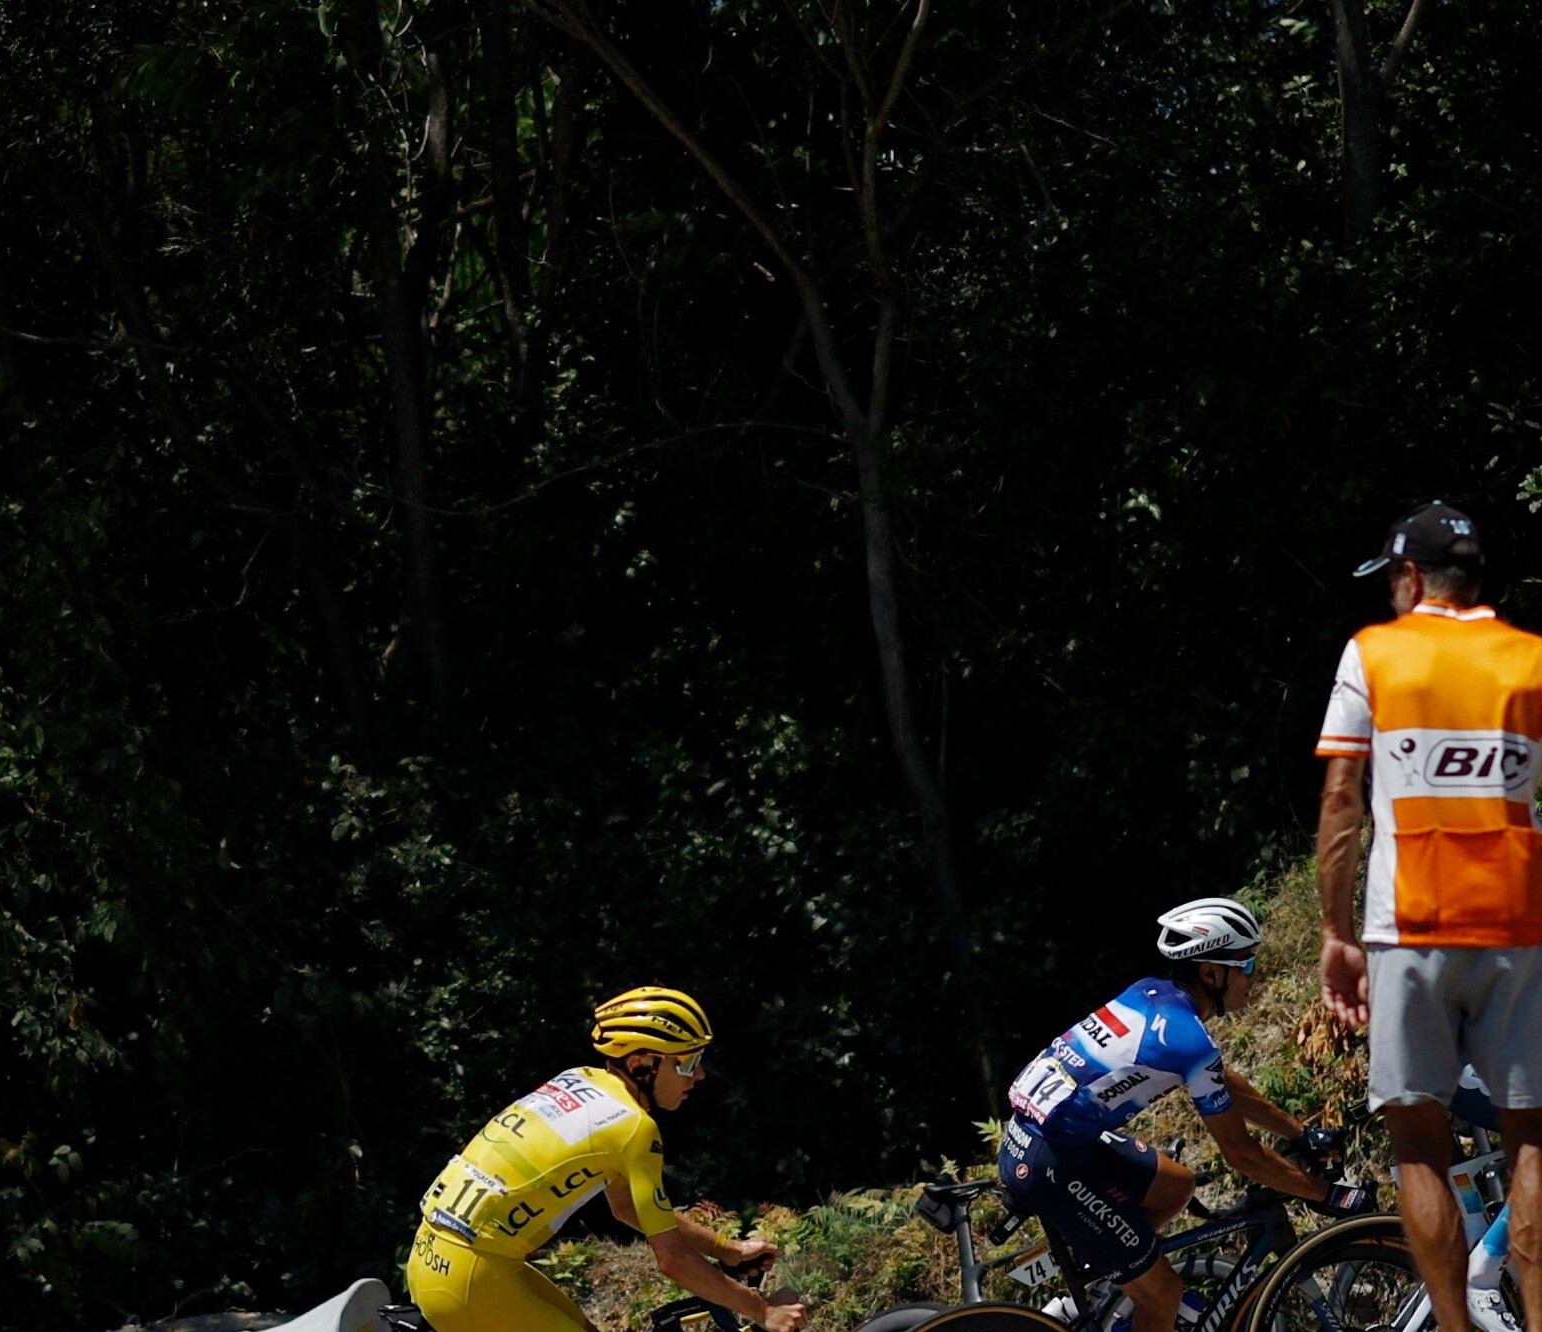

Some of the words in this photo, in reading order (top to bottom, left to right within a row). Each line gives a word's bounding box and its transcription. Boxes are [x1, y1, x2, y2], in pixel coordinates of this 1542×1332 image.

[1097, 1071, 1151, 1103] SOUDAL
[549, 1166, 604, 1199] LCL
[444, 1178, 489, 1226] 11
[498, 1201, 545, 1238] LCL
[1023, 1261, 1047, 1285] 74
